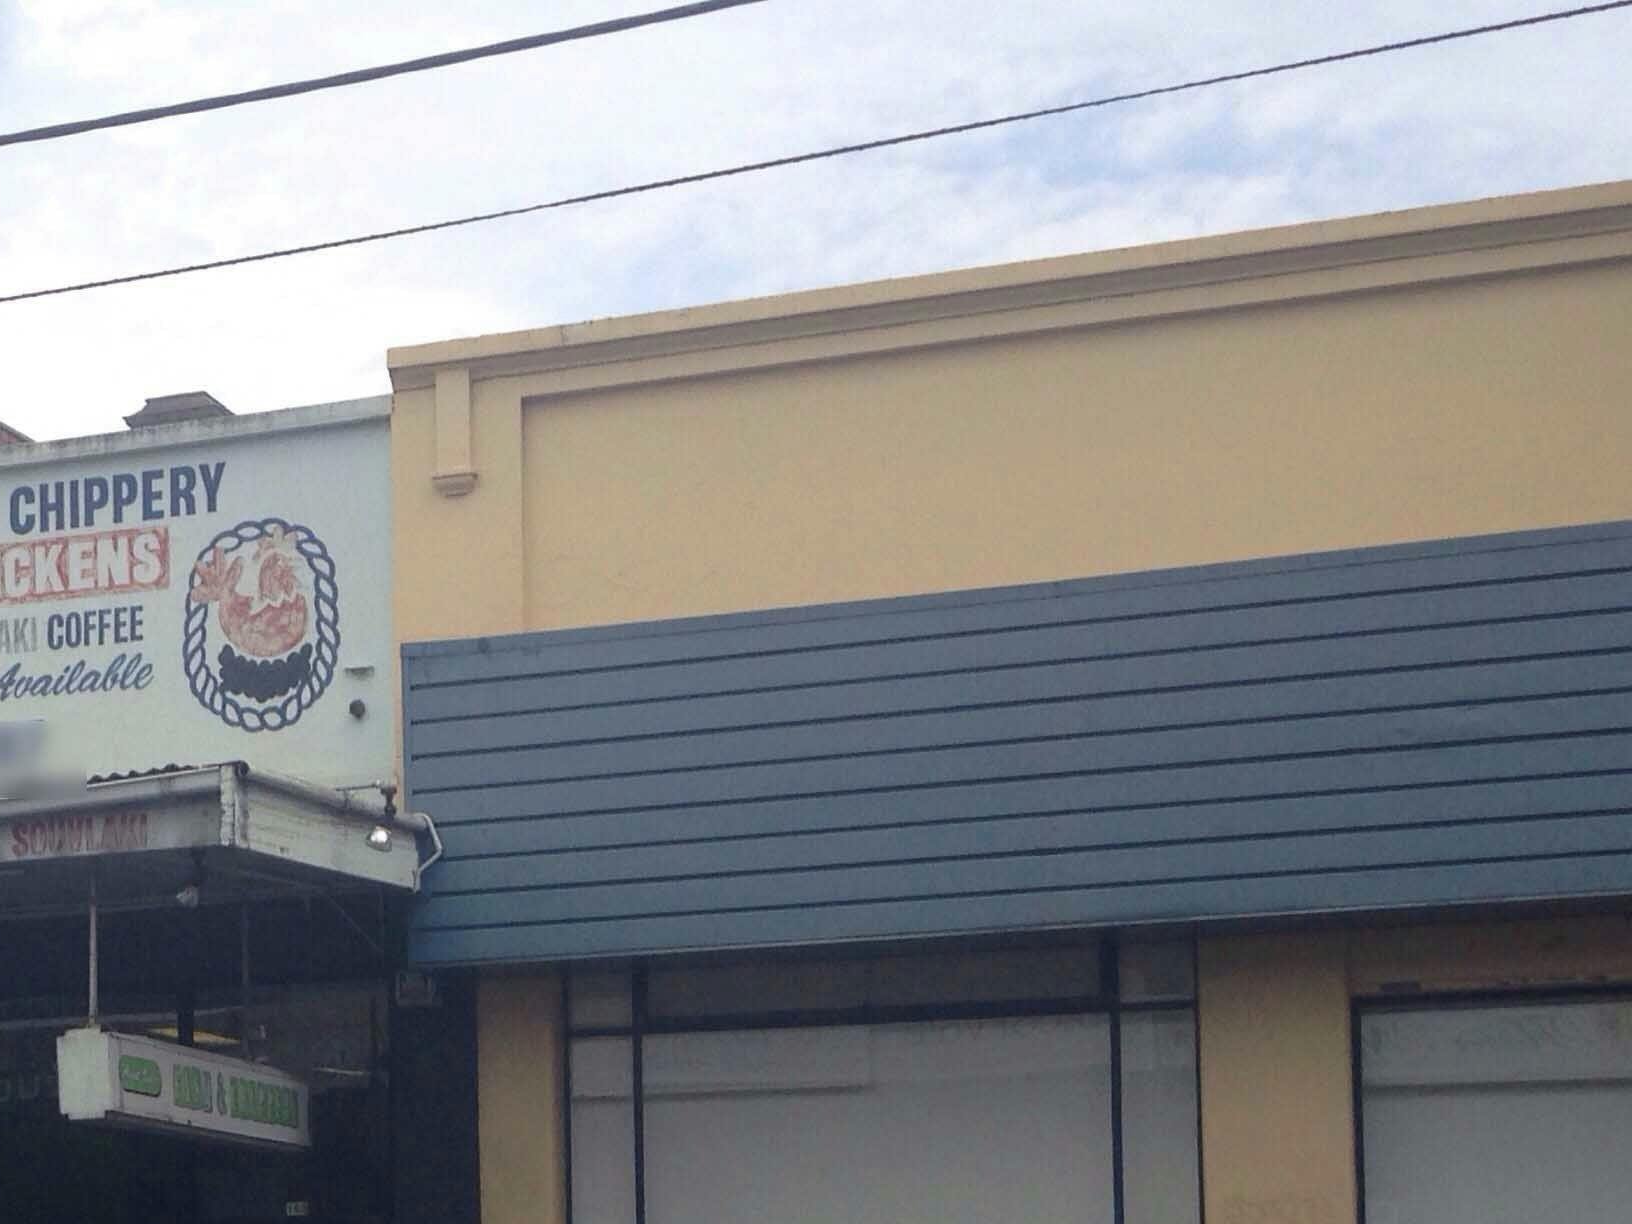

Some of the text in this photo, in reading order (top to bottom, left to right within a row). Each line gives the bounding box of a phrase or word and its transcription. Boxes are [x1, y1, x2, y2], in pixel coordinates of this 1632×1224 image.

[10, 462, 226, 535] CHIPPERY
[47, 605, 144, 650] COFFEE
[11, 813, 148, 858] SOUVLAKI
